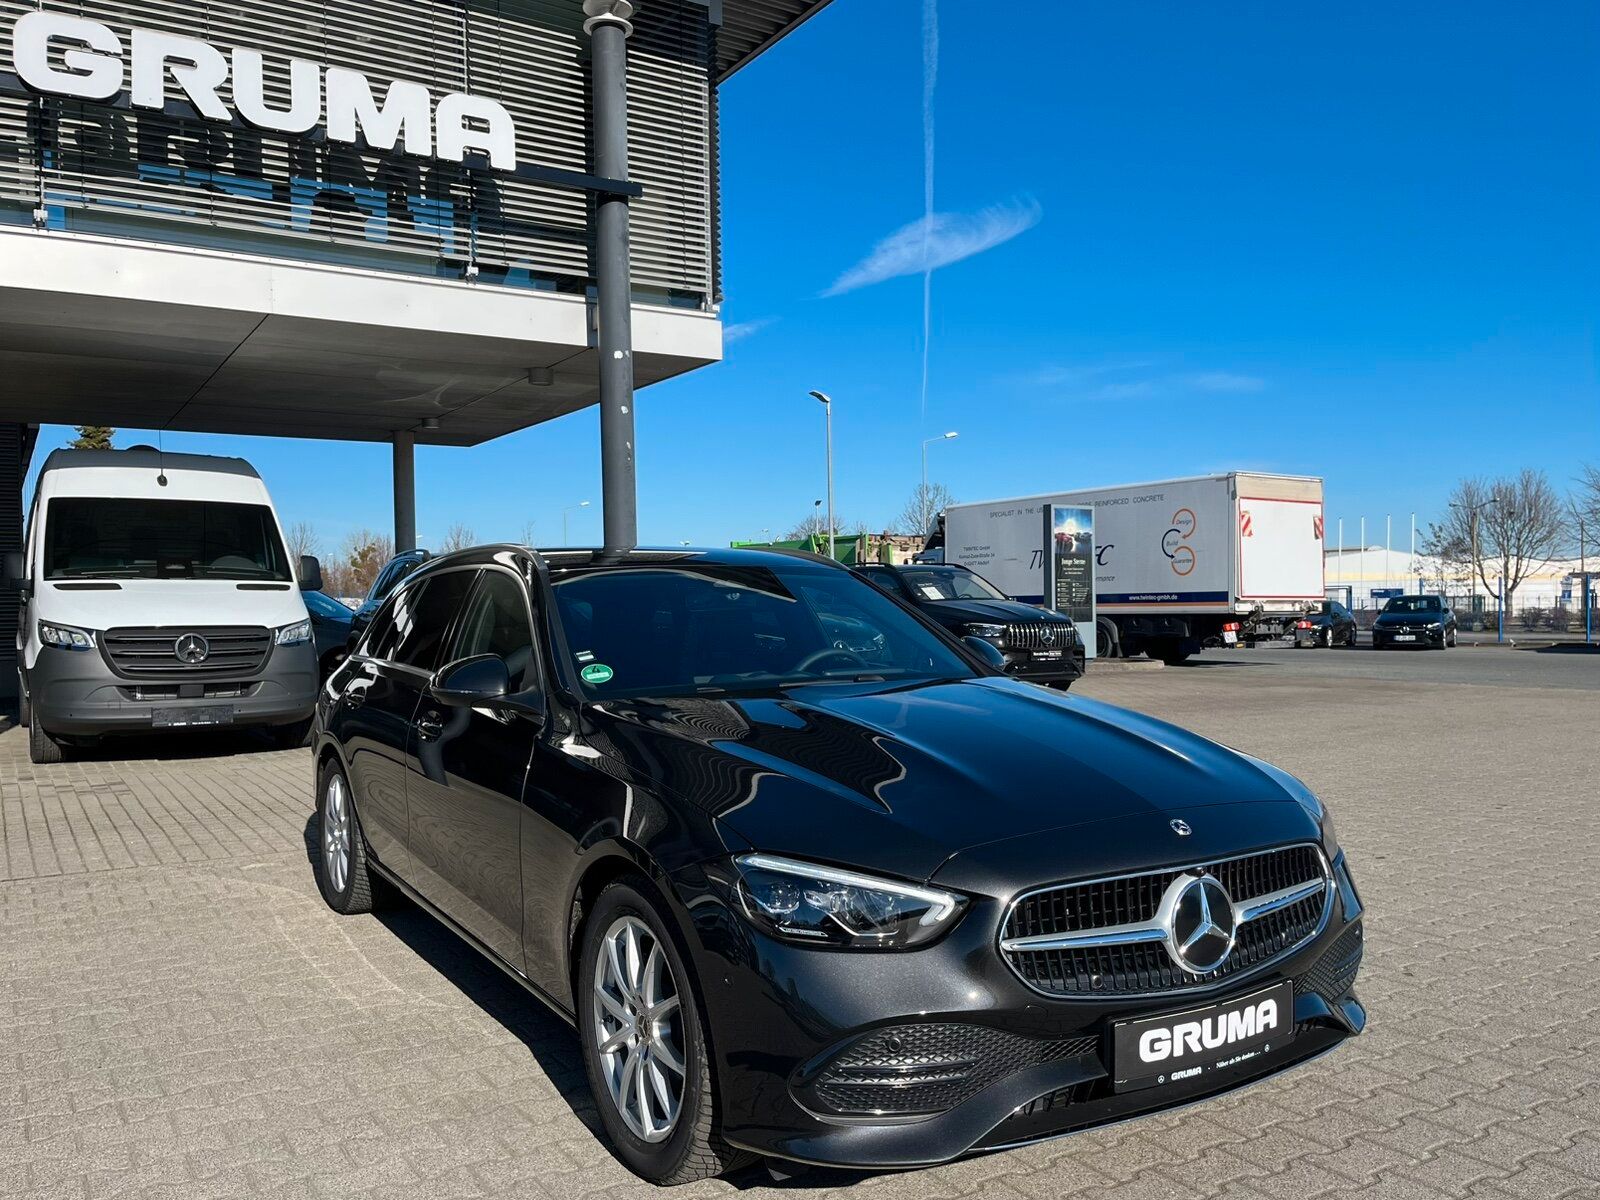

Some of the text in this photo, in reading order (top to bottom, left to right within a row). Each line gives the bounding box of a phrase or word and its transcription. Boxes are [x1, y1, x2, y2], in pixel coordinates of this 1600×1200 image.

[12, 10, 517, 171] GRUMA
[1094, 497, 1129, 507] REINFORCED
[1132, 494, 1164, 504] CONCRETE
[989, 509, 1015, 519] SPECIALIST
[1139, 998, 1278, 1064] GRUMA
[1170, 1066, 1203, 1081] GRUMA
